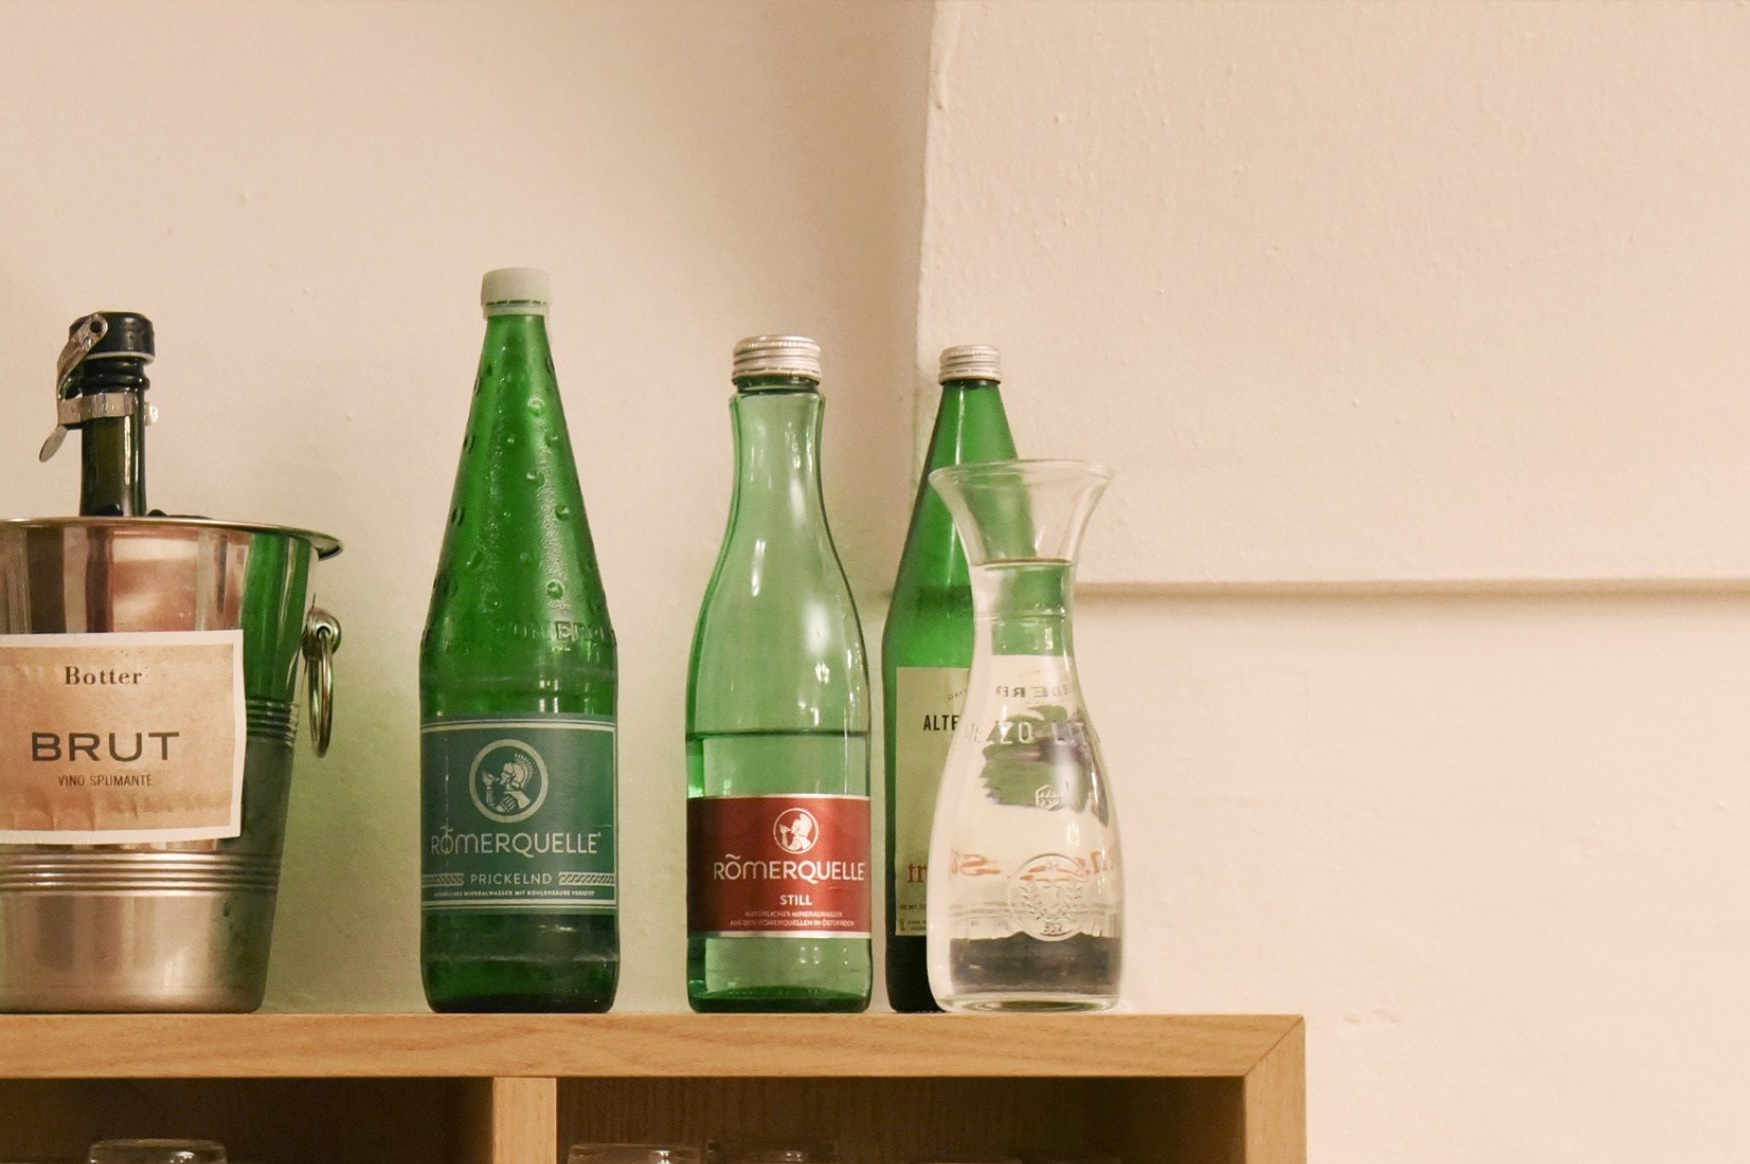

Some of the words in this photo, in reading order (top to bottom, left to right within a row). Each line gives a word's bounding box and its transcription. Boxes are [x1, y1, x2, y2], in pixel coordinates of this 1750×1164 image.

[64, 665, 143, 686] Botter
[31, 731, 181, 763] BRUT
[57, 774, 86, 787] VINO
[89, 773, 153, 787] SPUMANTE
[470, 872, 553, 886] PRICKELND
[779, 894, 813, 906] STILL
